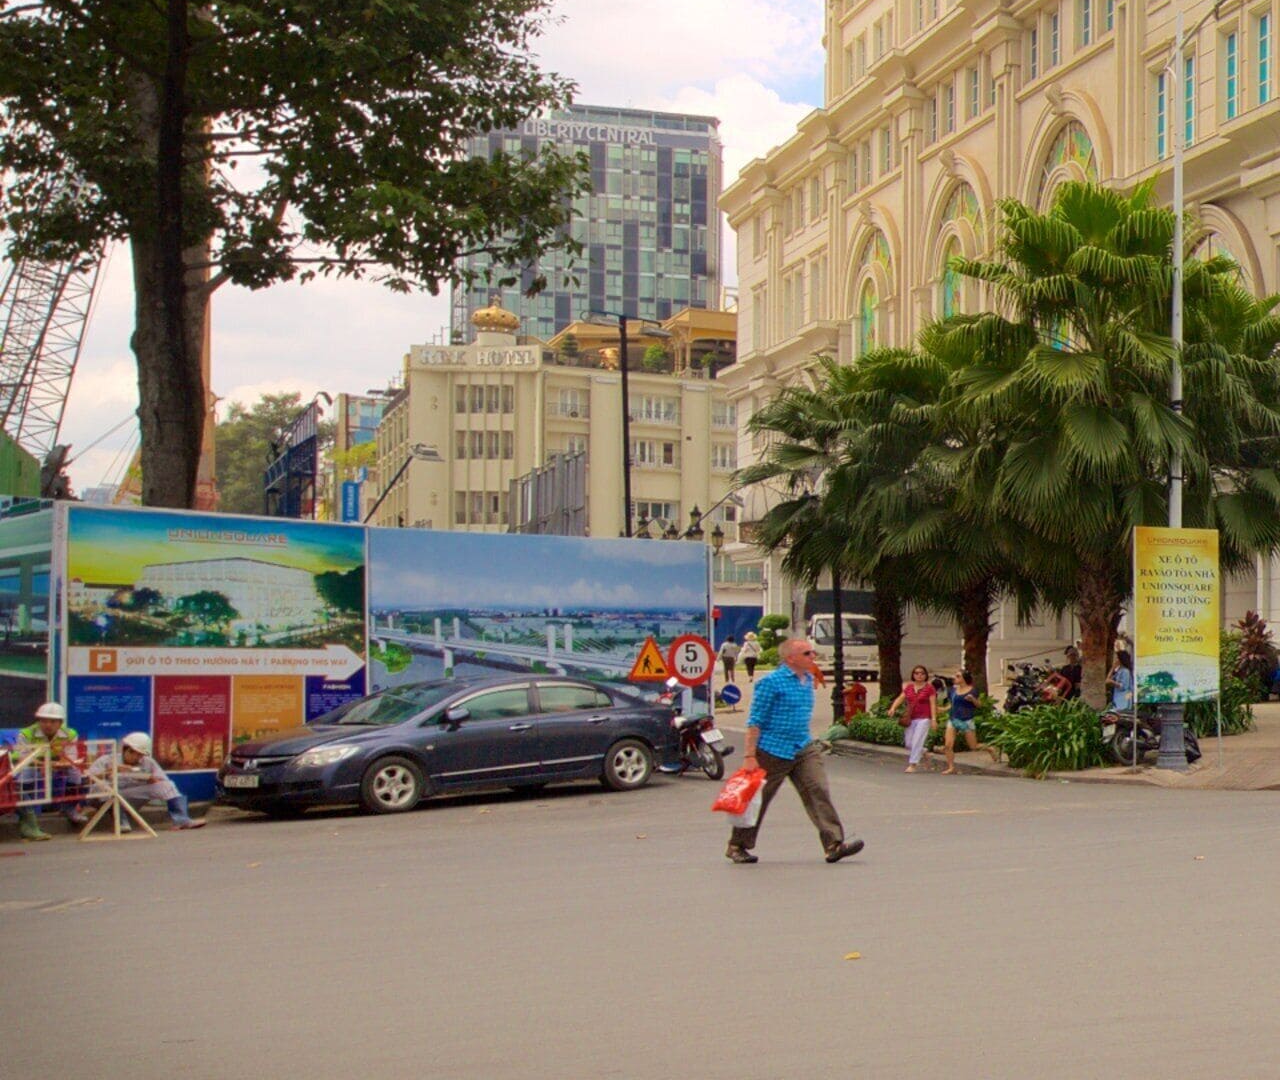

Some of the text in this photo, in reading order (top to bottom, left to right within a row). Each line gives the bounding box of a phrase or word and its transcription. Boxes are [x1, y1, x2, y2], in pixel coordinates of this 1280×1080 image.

[476, 350, 535, 366] HOTEL
[1159, 554, 1198, 565] XE Ô TÔ
[1142, 582, 1213, 591] UNIONSQUARE
[1146, 596, 1174, 604] THEO
[1162, 608, 1175, 618] LÊ
[685, 644, 697, 662] 5
[97, 654, 111, 669] P
[175, 657, 200, 665] THEO
[681, 665, 702, 674] km
